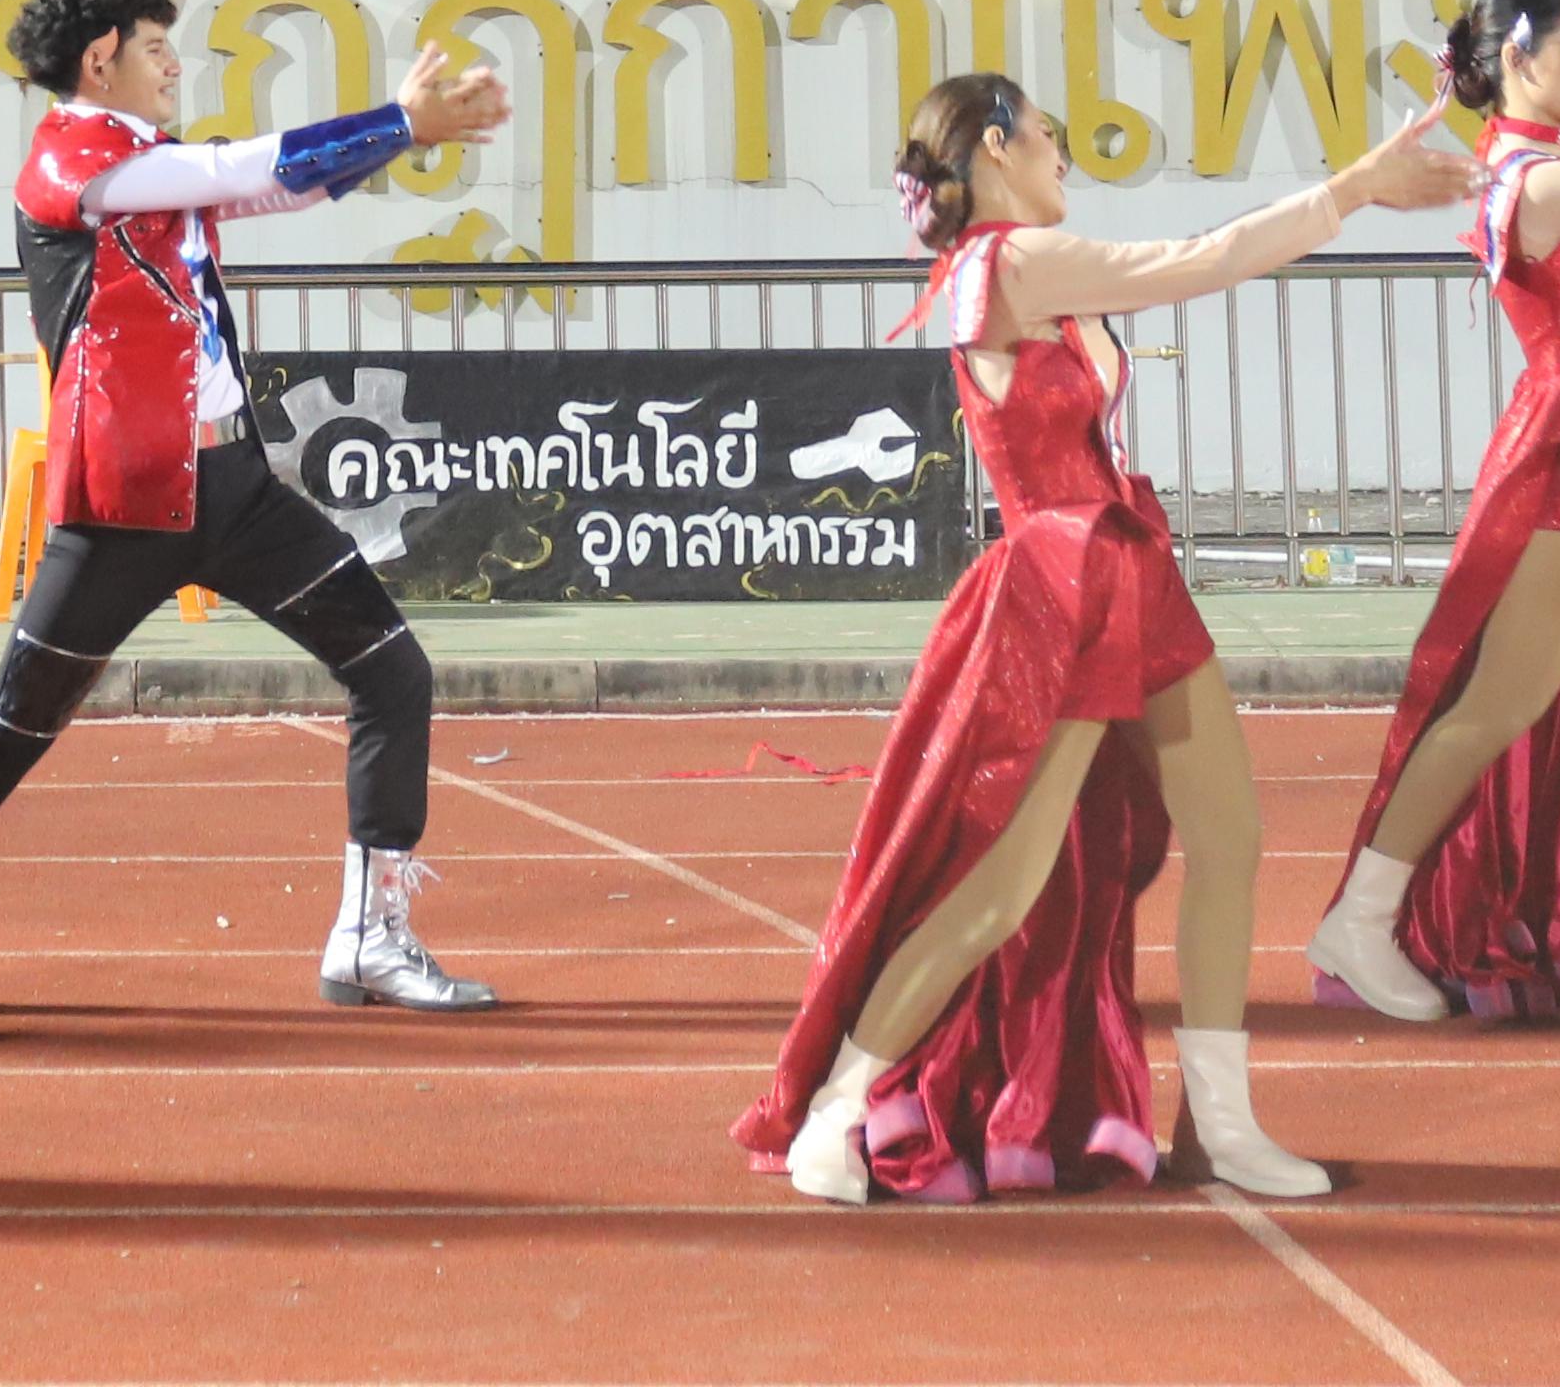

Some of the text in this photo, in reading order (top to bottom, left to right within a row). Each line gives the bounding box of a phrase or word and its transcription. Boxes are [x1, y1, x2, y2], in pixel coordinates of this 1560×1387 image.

[327, 399, 759, 499] คณะเทคโนโลยี
[576, 505, 916, 588] อุตสาหกรรม
